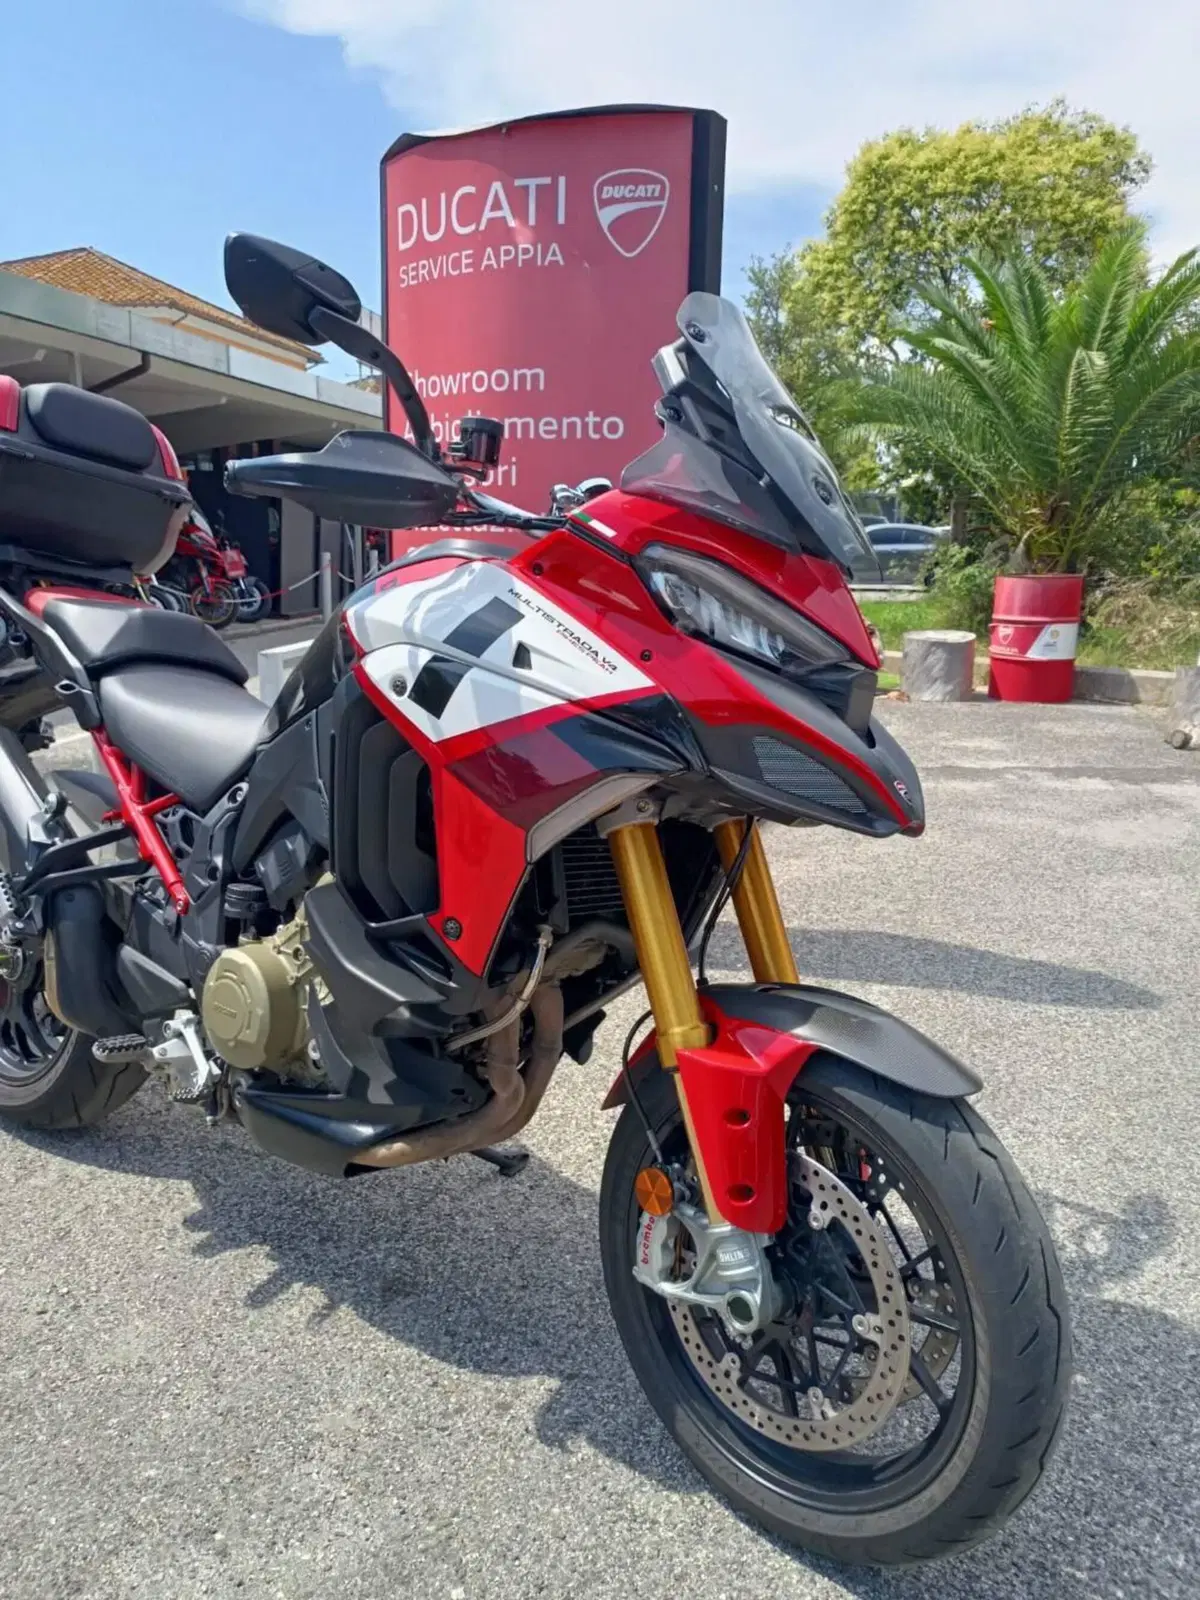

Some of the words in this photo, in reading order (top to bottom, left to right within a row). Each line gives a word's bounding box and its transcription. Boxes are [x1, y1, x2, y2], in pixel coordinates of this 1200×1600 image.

[397, 175, 567, 252] DUCATI
[601, 184, 661, 199] DUCATI
[399, 249, 474, 288] SERVICE
[480, 242, 565, 271] APPIA
[407, 366, 546, 398] howroom
[507, 588, 600, 658] MULTISTRADA
[602, 657, 618, 672] V4
[641, 1216, 655, 1265] brembo
